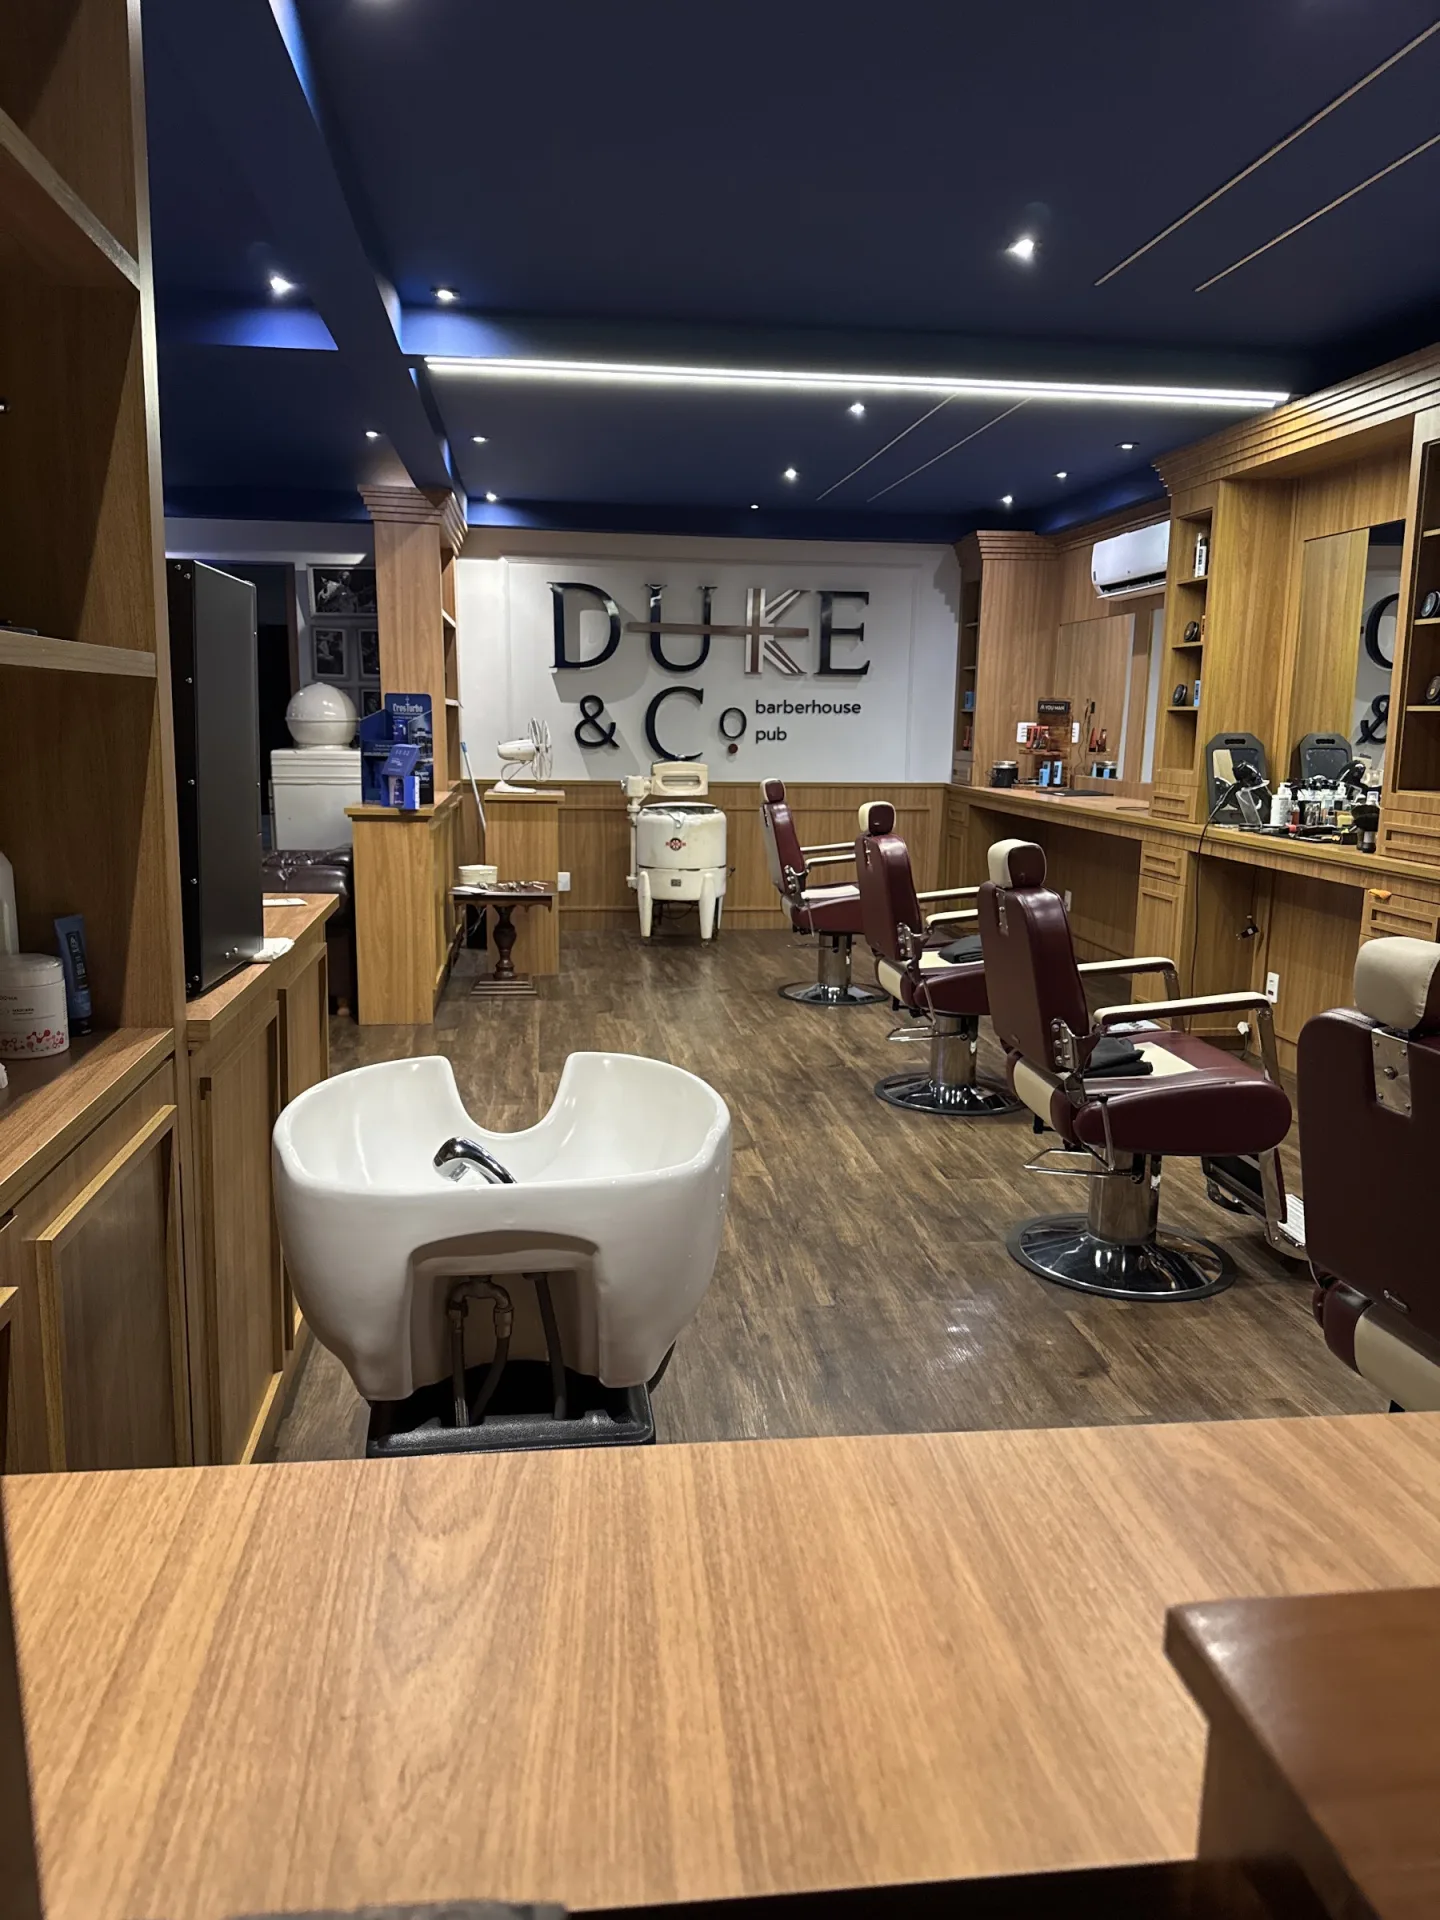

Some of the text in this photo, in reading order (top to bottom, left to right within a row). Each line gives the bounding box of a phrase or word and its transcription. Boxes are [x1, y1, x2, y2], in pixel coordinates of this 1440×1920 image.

[547, 581, 870, 676] DUKE
[574, 694, 620, 749] &
[755, 699, 862, 716] barberhouse
[755, 727, 787, 742] pub
